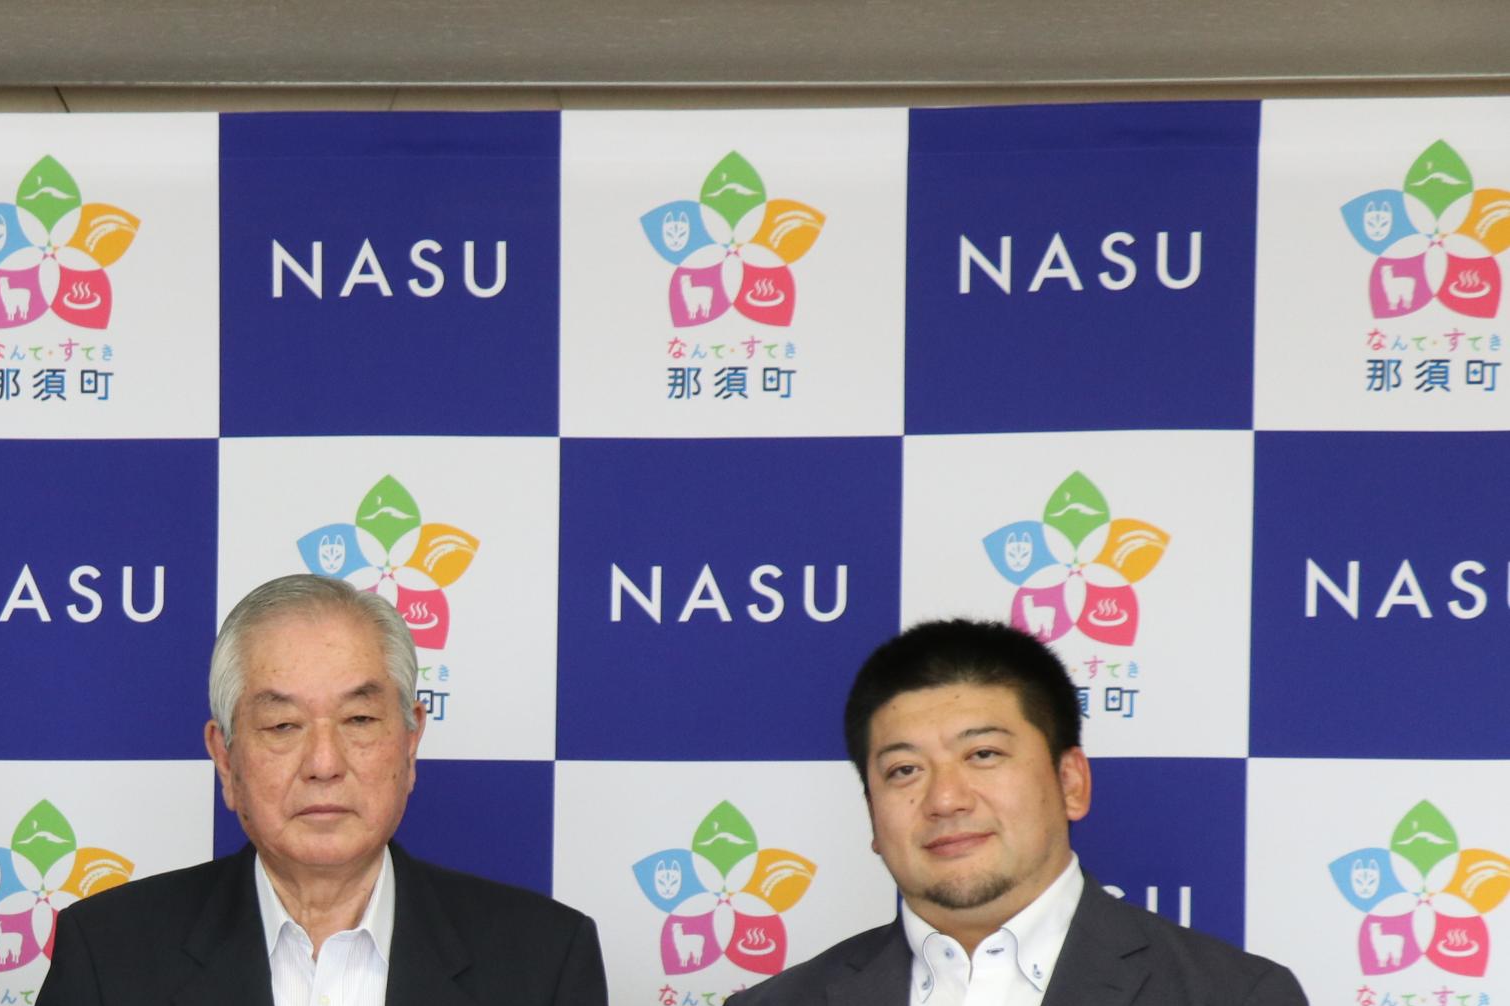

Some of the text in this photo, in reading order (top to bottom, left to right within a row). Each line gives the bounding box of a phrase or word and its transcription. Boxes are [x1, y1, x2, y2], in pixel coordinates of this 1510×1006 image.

[272, 238, 508, 300] NASU
[959, 231, 1203, 295] NASU
[667, 366, 797, 400] 那須町
[1366, 358, 1502, 393] 那須町
[609, 562, 849, 624] NASU
[1305, 557, 1510, 620] NAS
